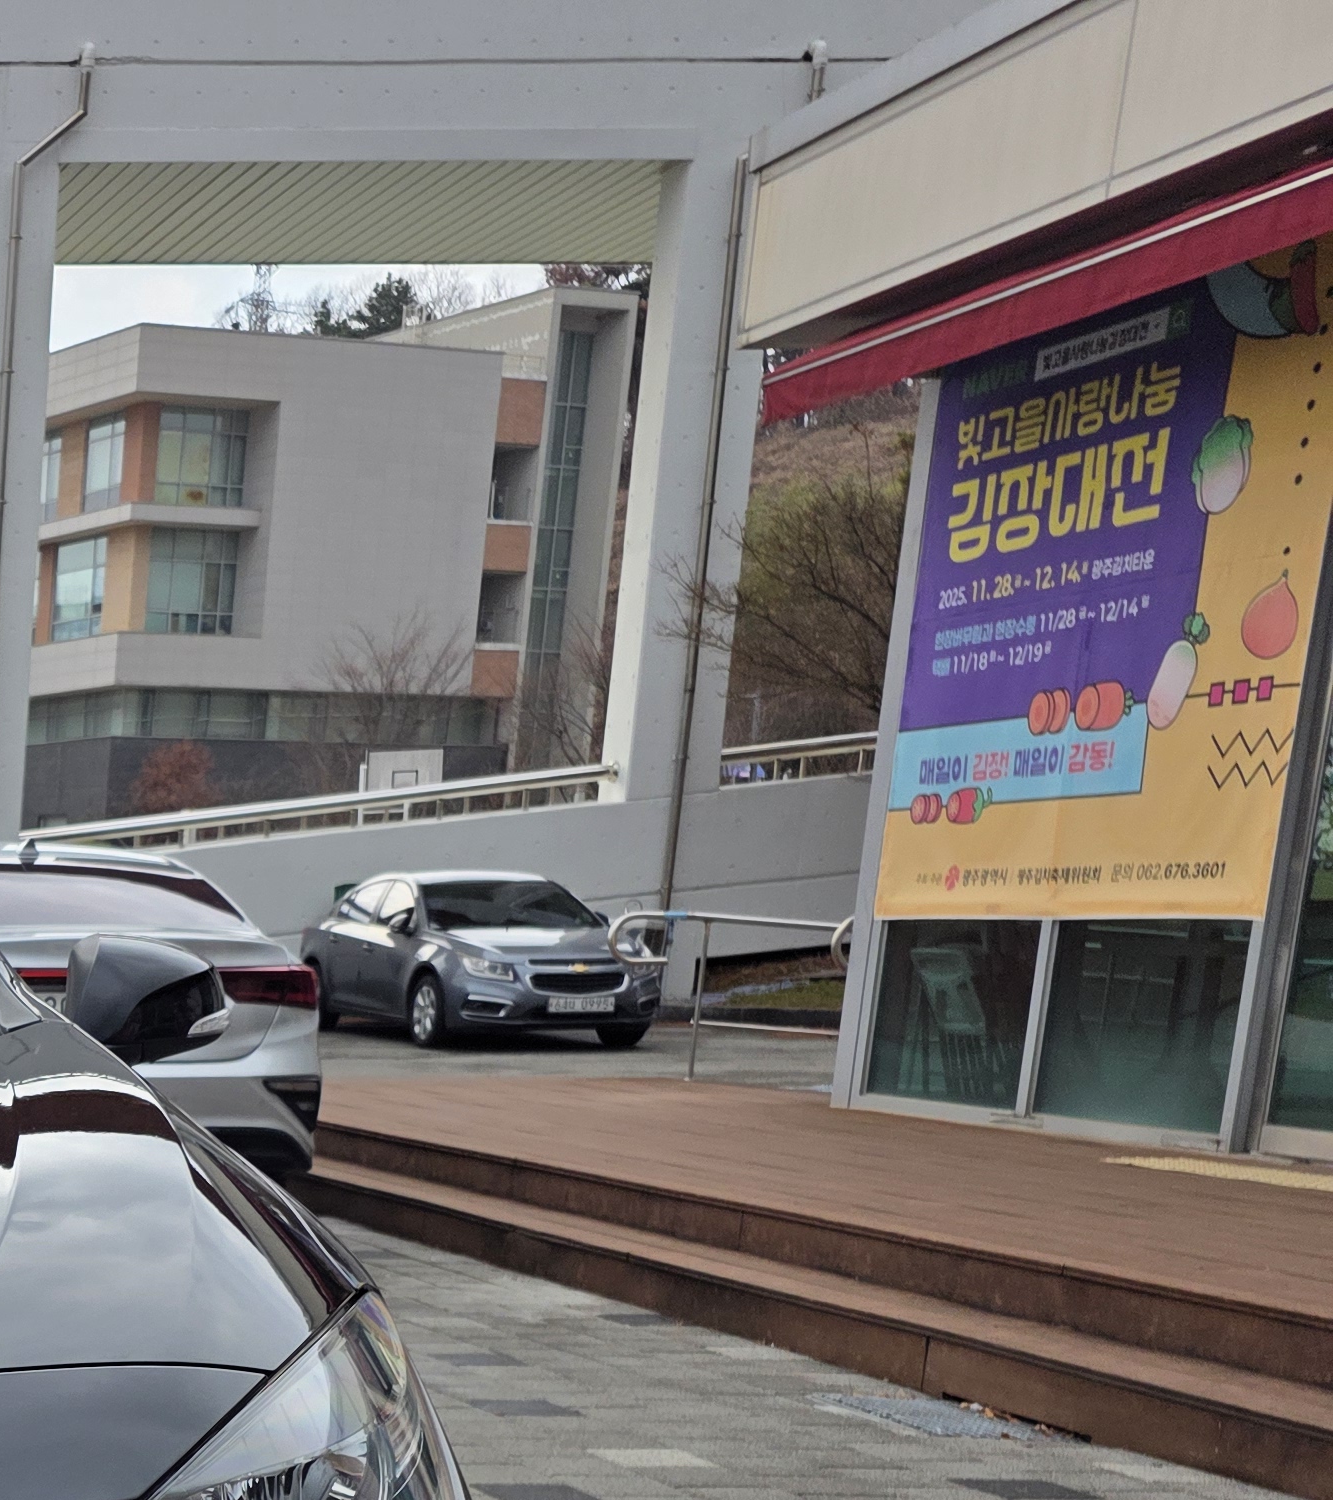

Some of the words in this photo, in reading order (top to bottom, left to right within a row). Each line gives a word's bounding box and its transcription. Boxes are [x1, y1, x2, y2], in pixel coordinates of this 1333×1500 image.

[956, 360, 1182, 471] 빛고을사랑나눔
[947, 427, 1172, 564] 김장대전
[919, 753, 969, 786] 매일이
[972, 751, 1010, 783] 김장!
[1013, 744, 1066, 779] 매일이
[1068, 741, 1116, 775] 감동!
[1111, 862, 1133, 884] 문의
[1136, 860, 1227, 881] 062.676.3601
